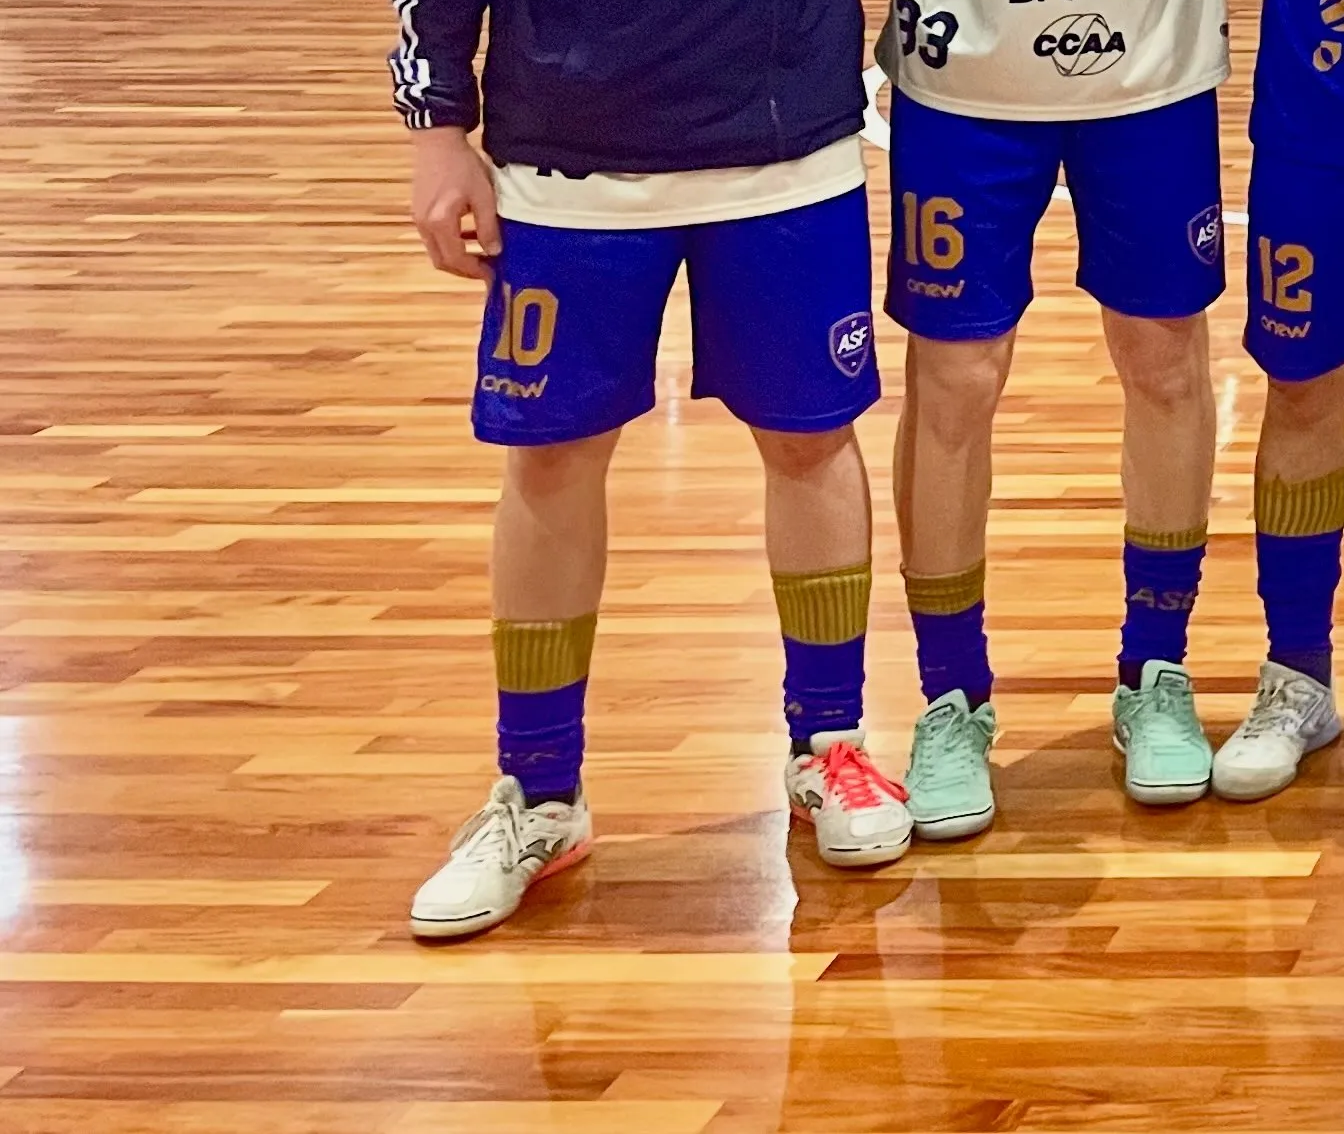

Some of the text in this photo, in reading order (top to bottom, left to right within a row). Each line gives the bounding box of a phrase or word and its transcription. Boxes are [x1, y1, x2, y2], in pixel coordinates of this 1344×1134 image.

[1033, 32, 1126, 57] CCAA
[902, 191, 964, 270] 16
[1258, 236, 1314, 312] 12
[492, 281, 559, 366] 10
[837, 324, 868, 355] ASF
